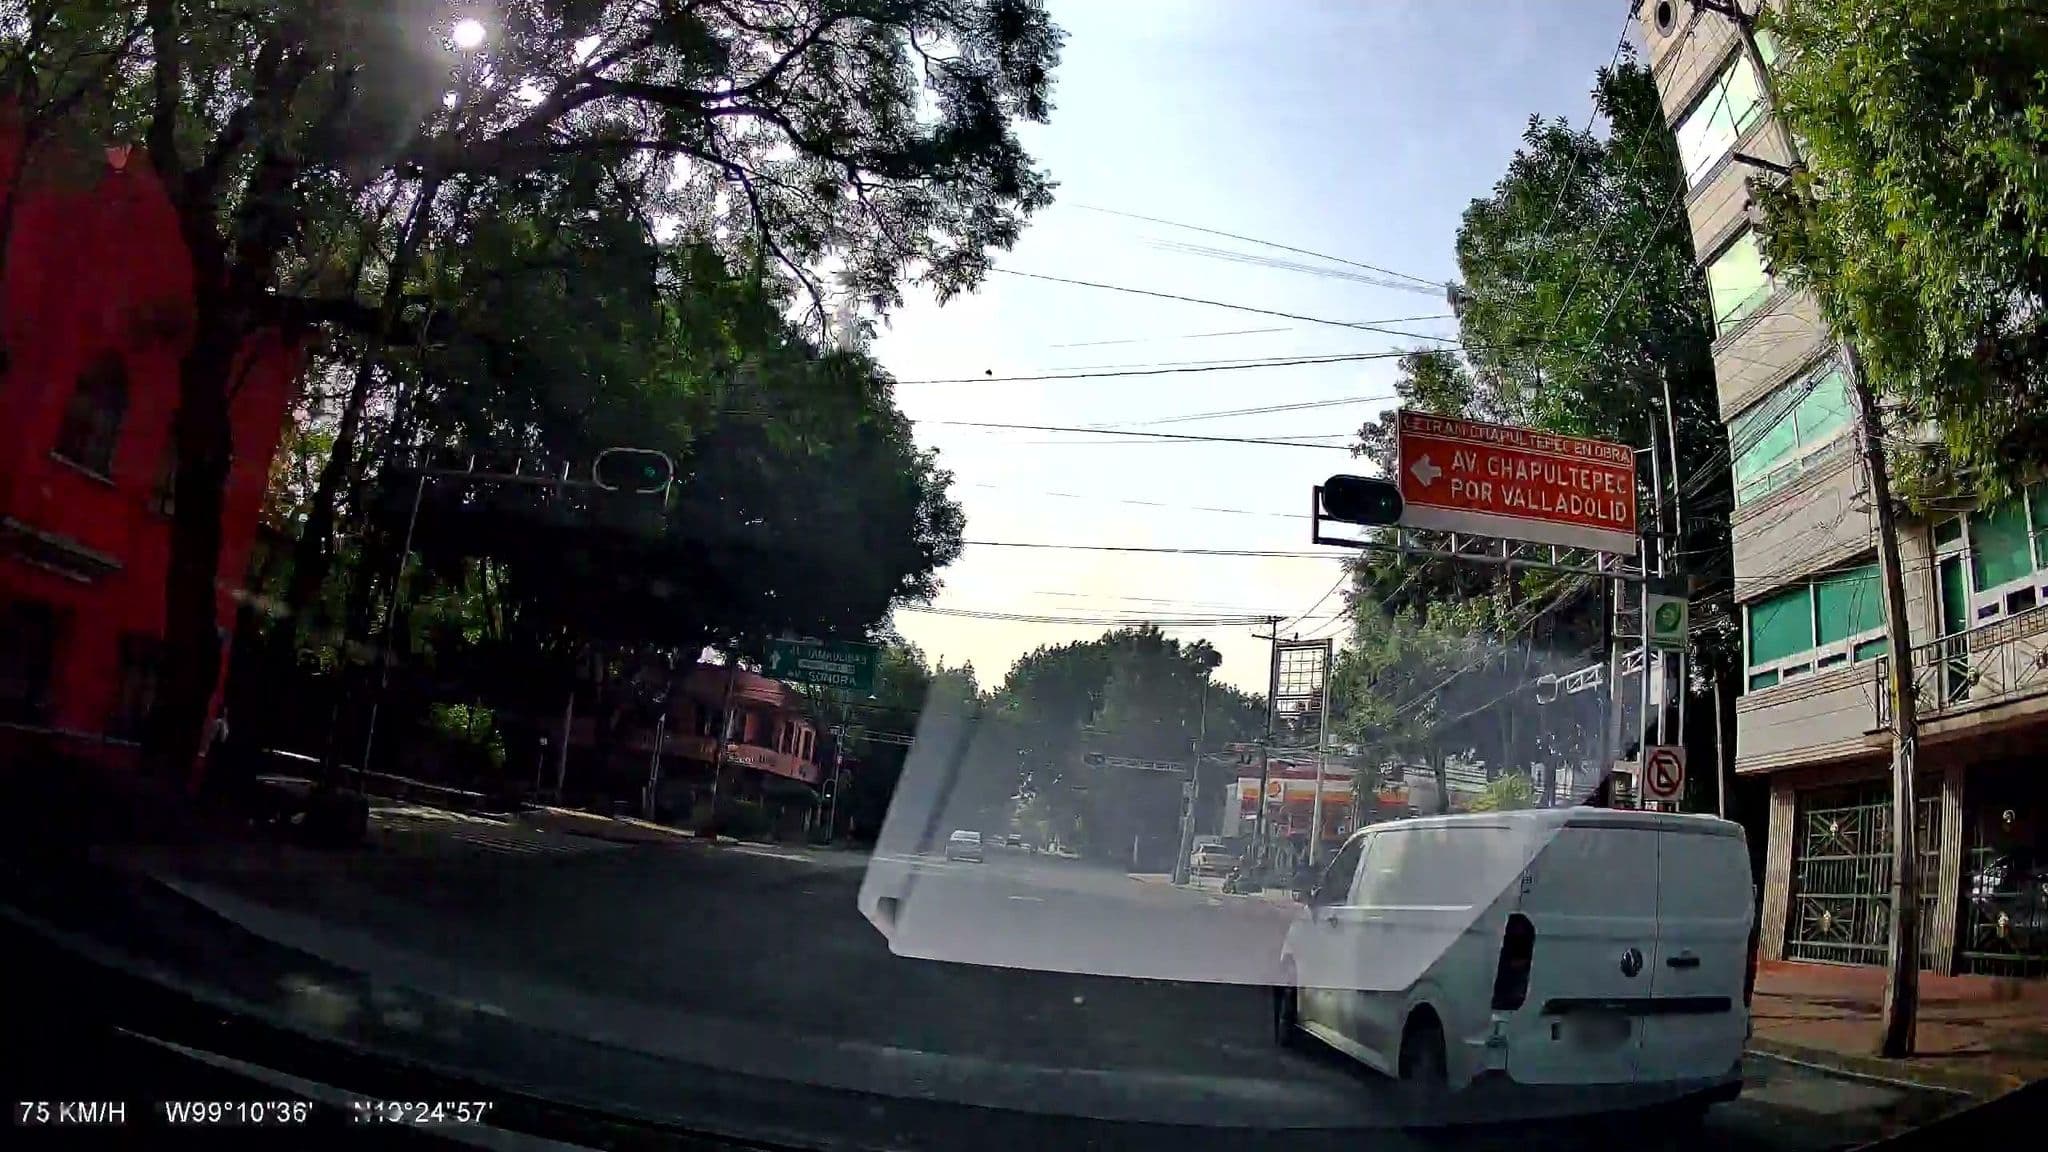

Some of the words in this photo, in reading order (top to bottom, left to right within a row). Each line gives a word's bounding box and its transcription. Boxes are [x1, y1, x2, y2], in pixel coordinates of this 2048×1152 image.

[1574, 441, 1592, 456] EN
[1594, 447, 1631, 464] OBRA
[1487, 456, 1627, 494] CHAPULTEPEC
[1451, 478, 1492, 503] POR
[1500, 484, 1627, 522] VALLADOLID
